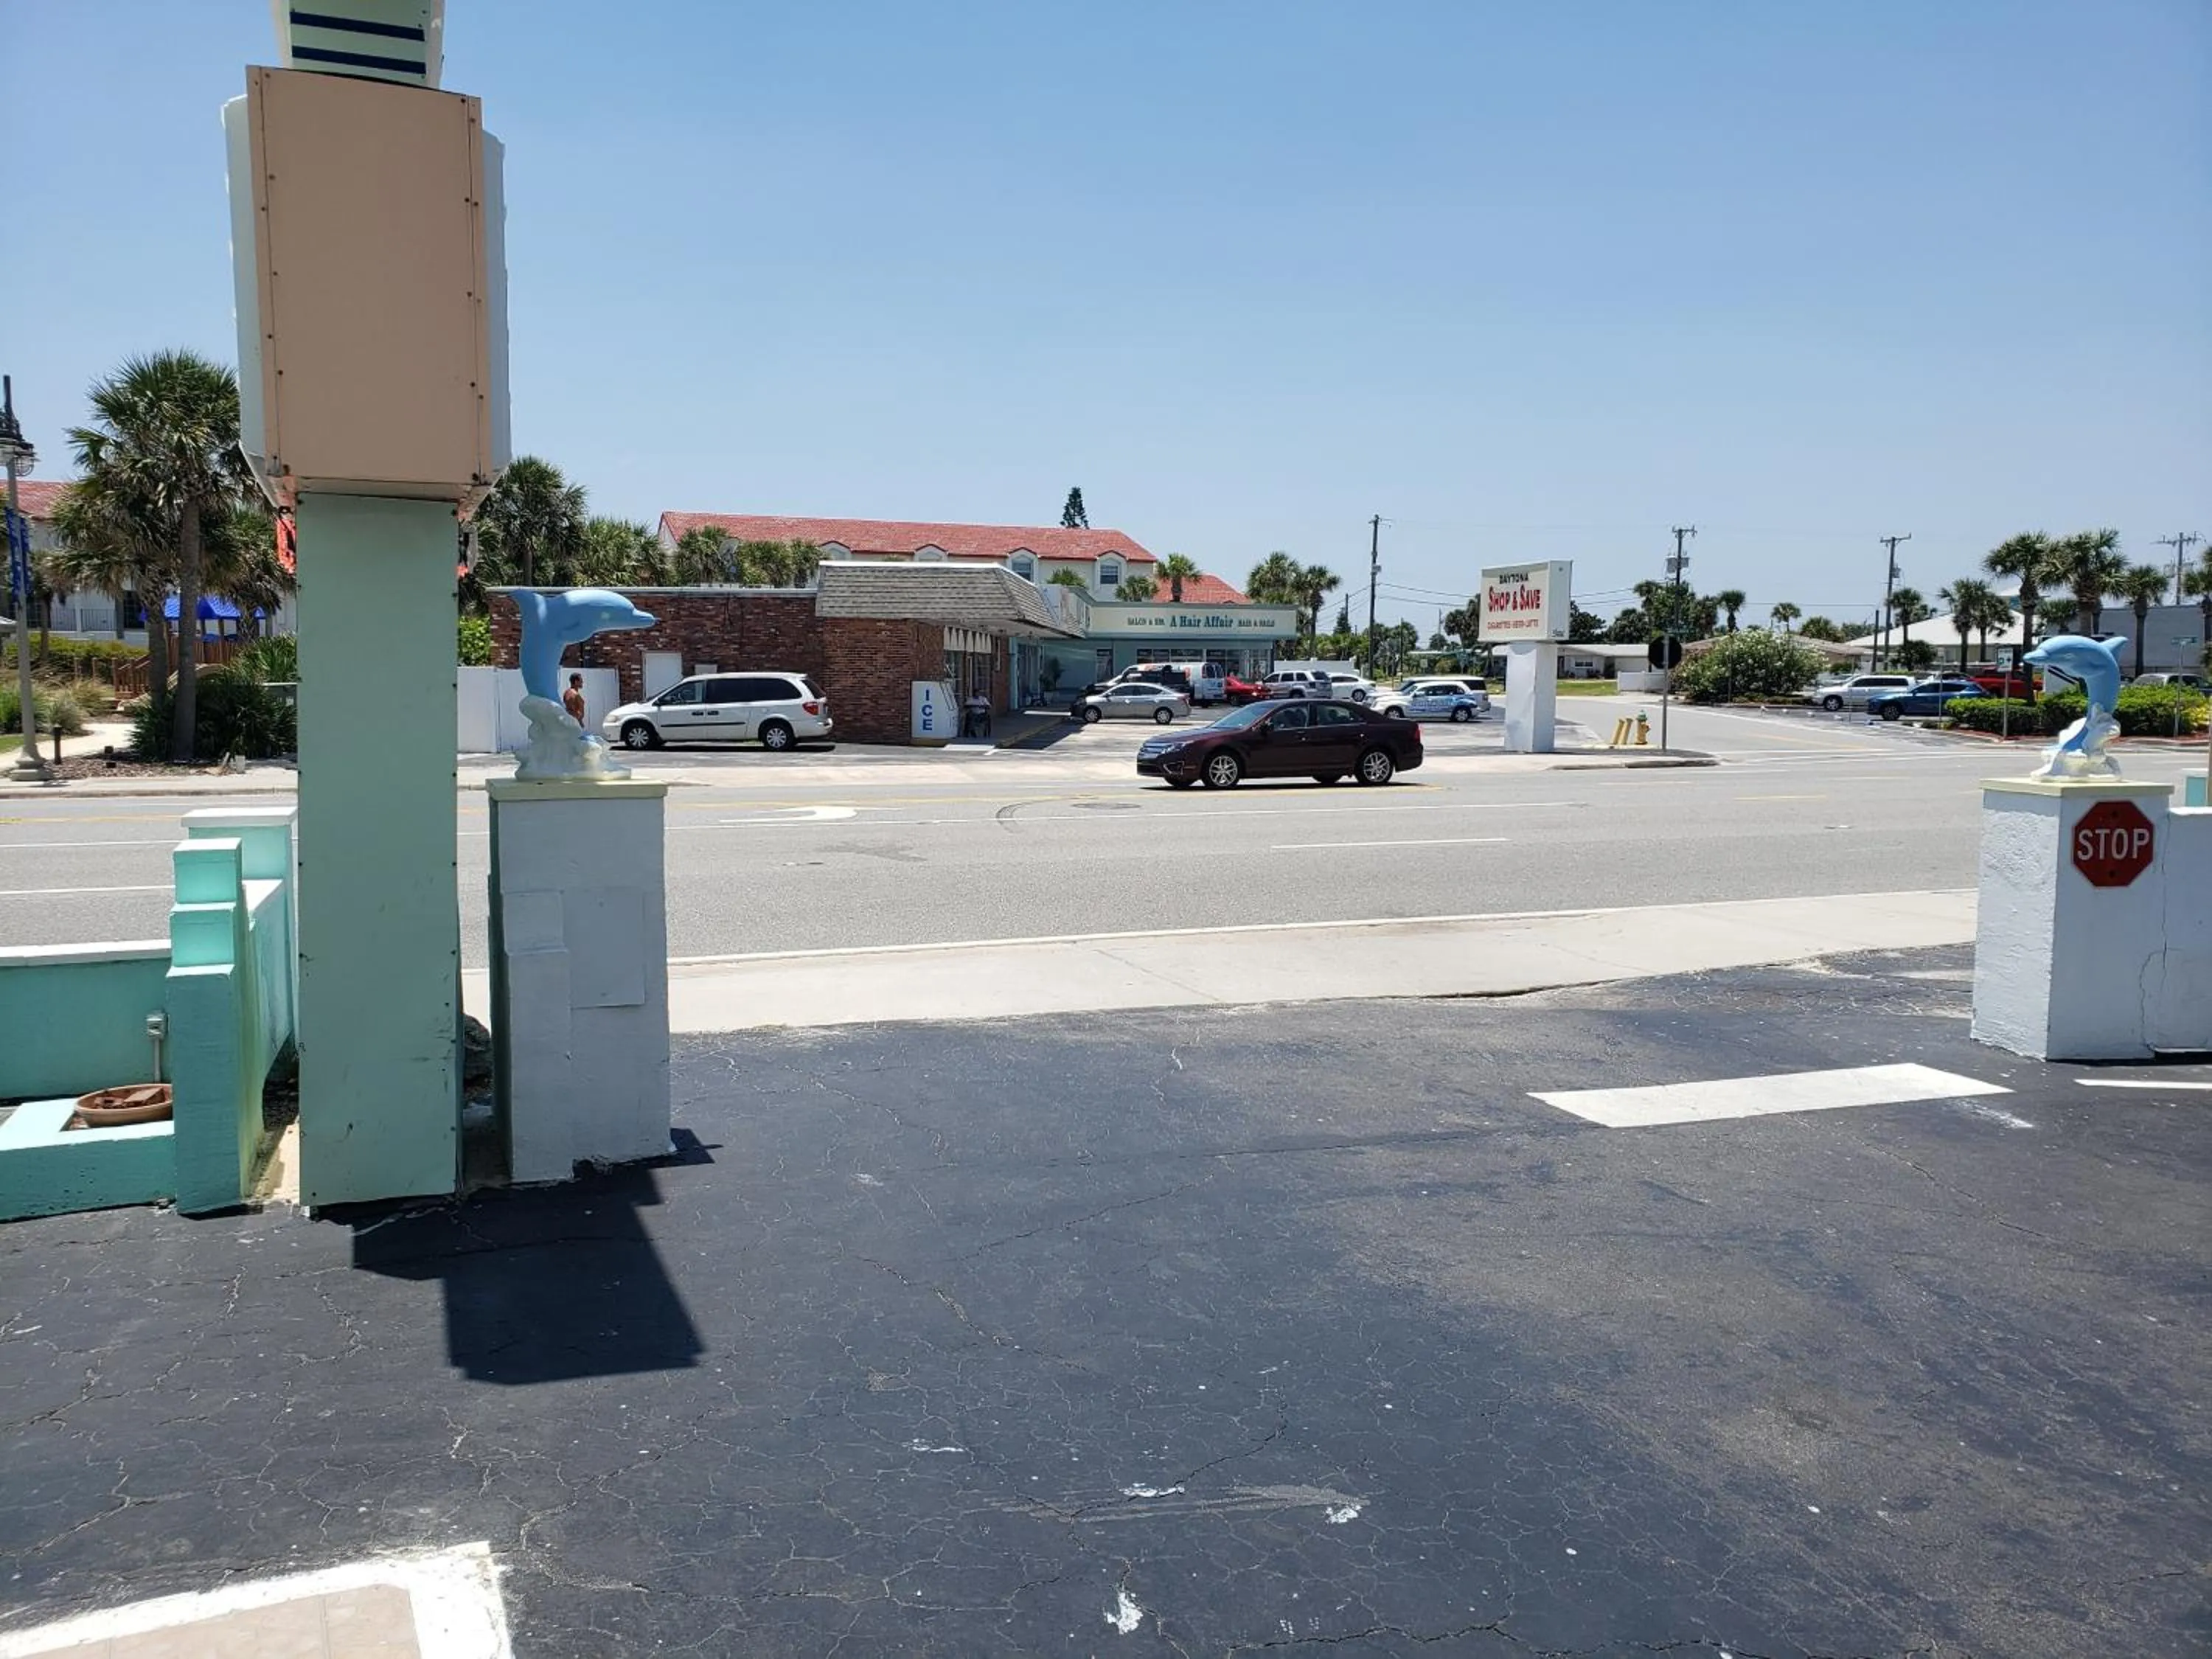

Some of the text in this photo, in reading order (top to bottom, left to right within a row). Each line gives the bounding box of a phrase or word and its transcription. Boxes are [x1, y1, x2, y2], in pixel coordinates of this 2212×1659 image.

[1499, 573, 1528, 584] DAYTONA
[1489, 584, 1540, 612] SHOP & SAVE
[1169, 615, 1178, 627] A
[1180, 615, 1201, 627] Hair
[1204, 614, 1233, 627] Affair
[922, 689, 933, 731] ICE
[2077, 828, 2150, 860] STOP
